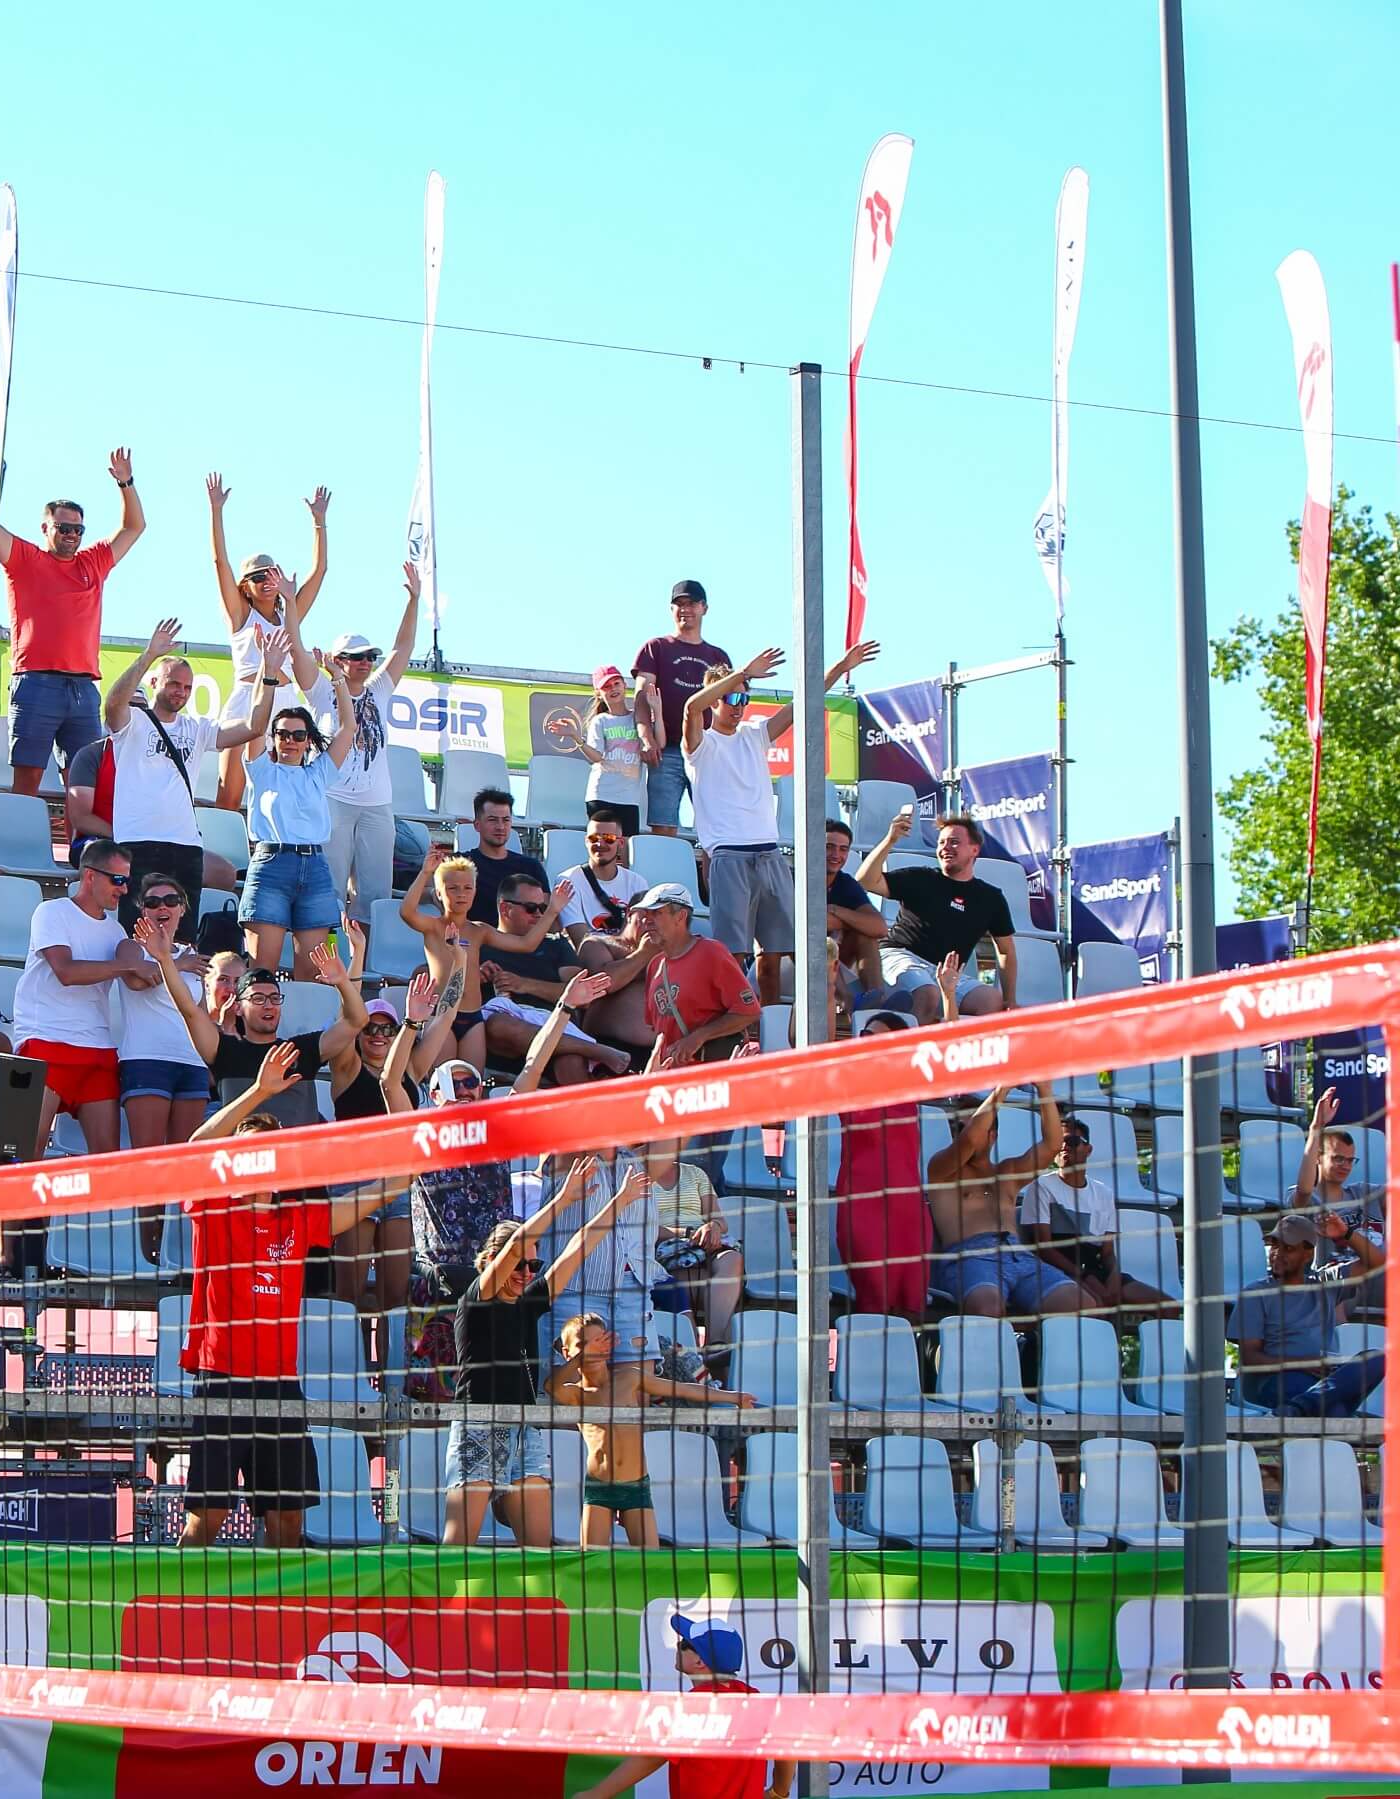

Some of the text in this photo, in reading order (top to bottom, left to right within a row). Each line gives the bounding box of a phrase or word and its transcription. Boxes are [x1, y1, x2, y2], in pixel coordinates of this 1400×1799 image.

[451, 736, 489, 750] OLSZTYN
[866, 720, 937, 747] SandSport
[918, 800, 934, 818] ACH
[970, 795, 1046, 821] SandSport
[1080, 877, 1162, 904] SandSport
[1256, 977, 1333, 1019] ORLEN
[944, 1035, 1009, 1072] ORLEN
[1324, 1054, 1388, 1078] SandSp
[673, 1081, 729, 1115] ORLEN
[439, 1120, 487, 1149] ORLEN
[232, 1150, 276, 1177] ORLEN
[51, 1173, 89, 1198] ORLEN
[252, 1284, 280, 1296] ORLEN
[760, 1637, 1015, 1670] OLVO
[943, 1715, 1007, 1745] ORLEN
[1255, 1714, 1330, 1749] ORLEN
[254, 1741, 443, 1787] ORLEN
[853, 1761, 944, 1786] AUTO
